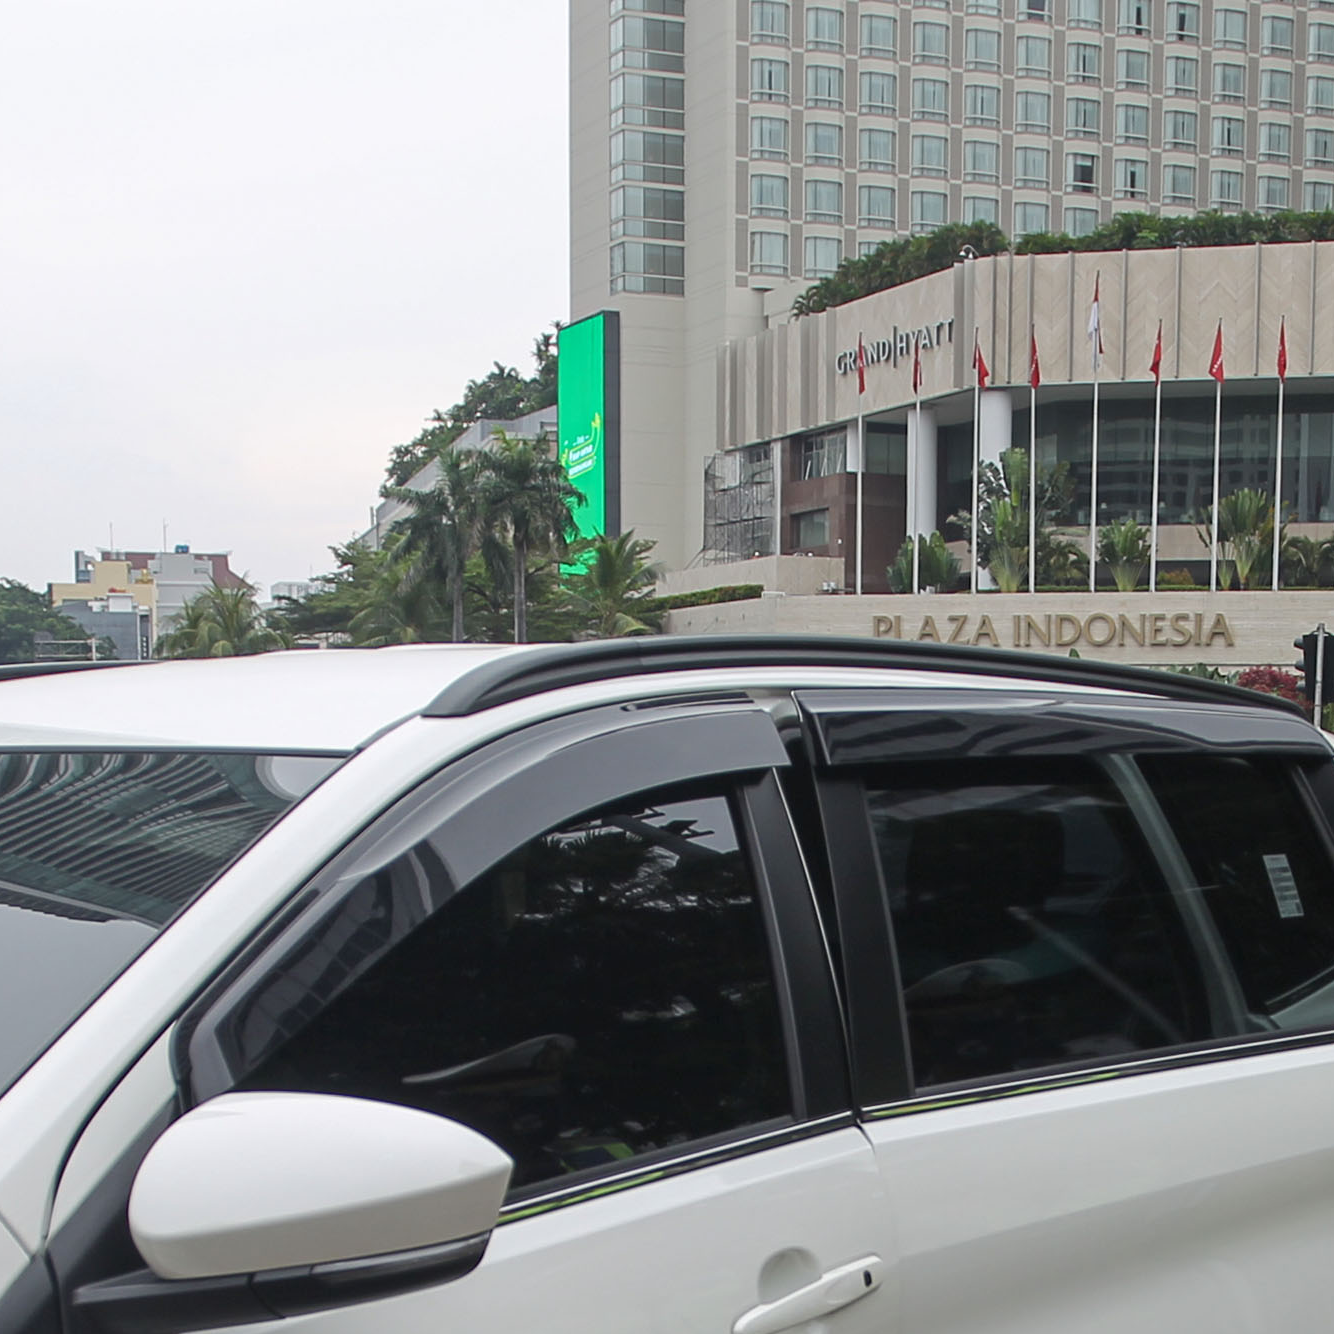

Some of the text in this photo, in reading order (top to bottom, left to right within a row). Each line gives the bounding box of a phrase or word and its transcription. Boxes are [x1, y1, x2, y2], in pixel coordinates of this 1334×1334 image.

[897, 317, 954, 357] HYATT
[872, 612, 1236, 648] PLAZA INDONESIA
